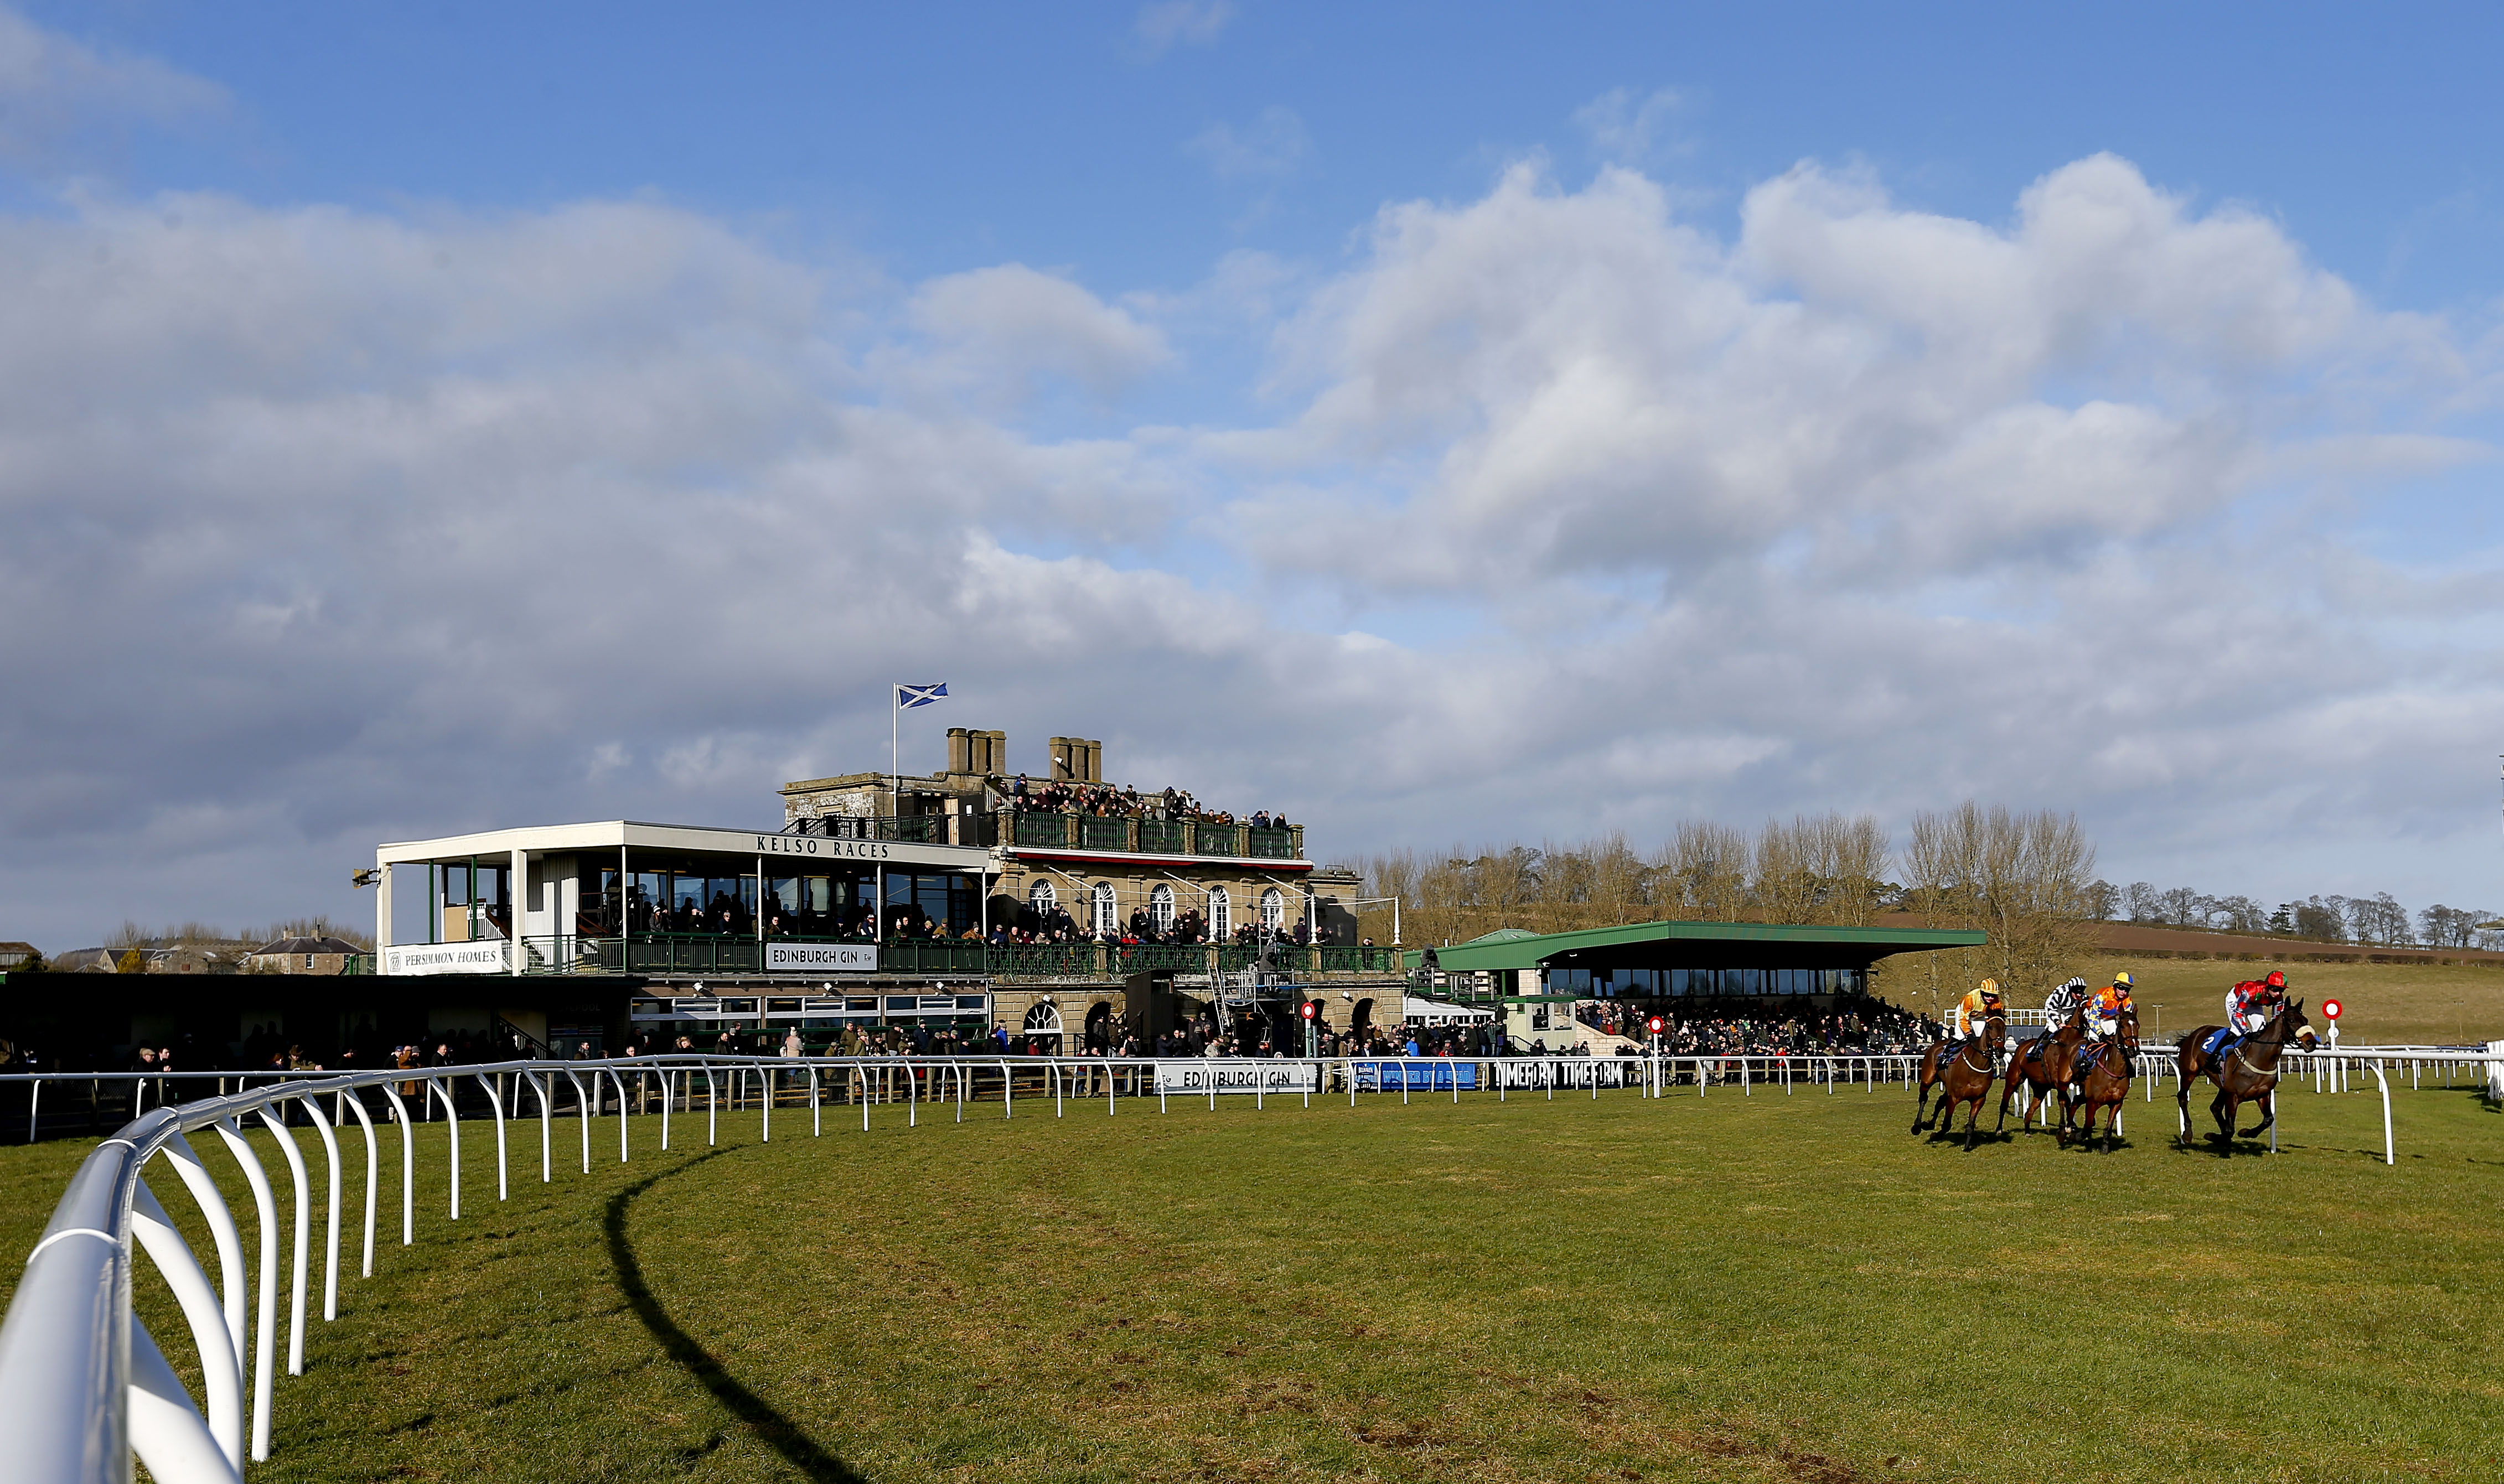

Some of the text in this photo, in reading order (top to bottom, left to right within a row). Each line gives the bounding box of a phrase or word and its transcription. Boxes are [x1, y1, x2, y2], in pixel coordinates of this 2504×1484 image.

[757, 836, 888, 858] KELSO RACES
[406, 951, 496, 966] PERSIMMON HOMES
[774, 949, 857, 963] EDINBURGH GIN
[2202, 1036, 2215, 1050] 2
[1269, 1071, 1290, 1086] GIN
[1437, 1070, 1444, 1083] A
[1446, 1070, 1470, 1083] HAD
